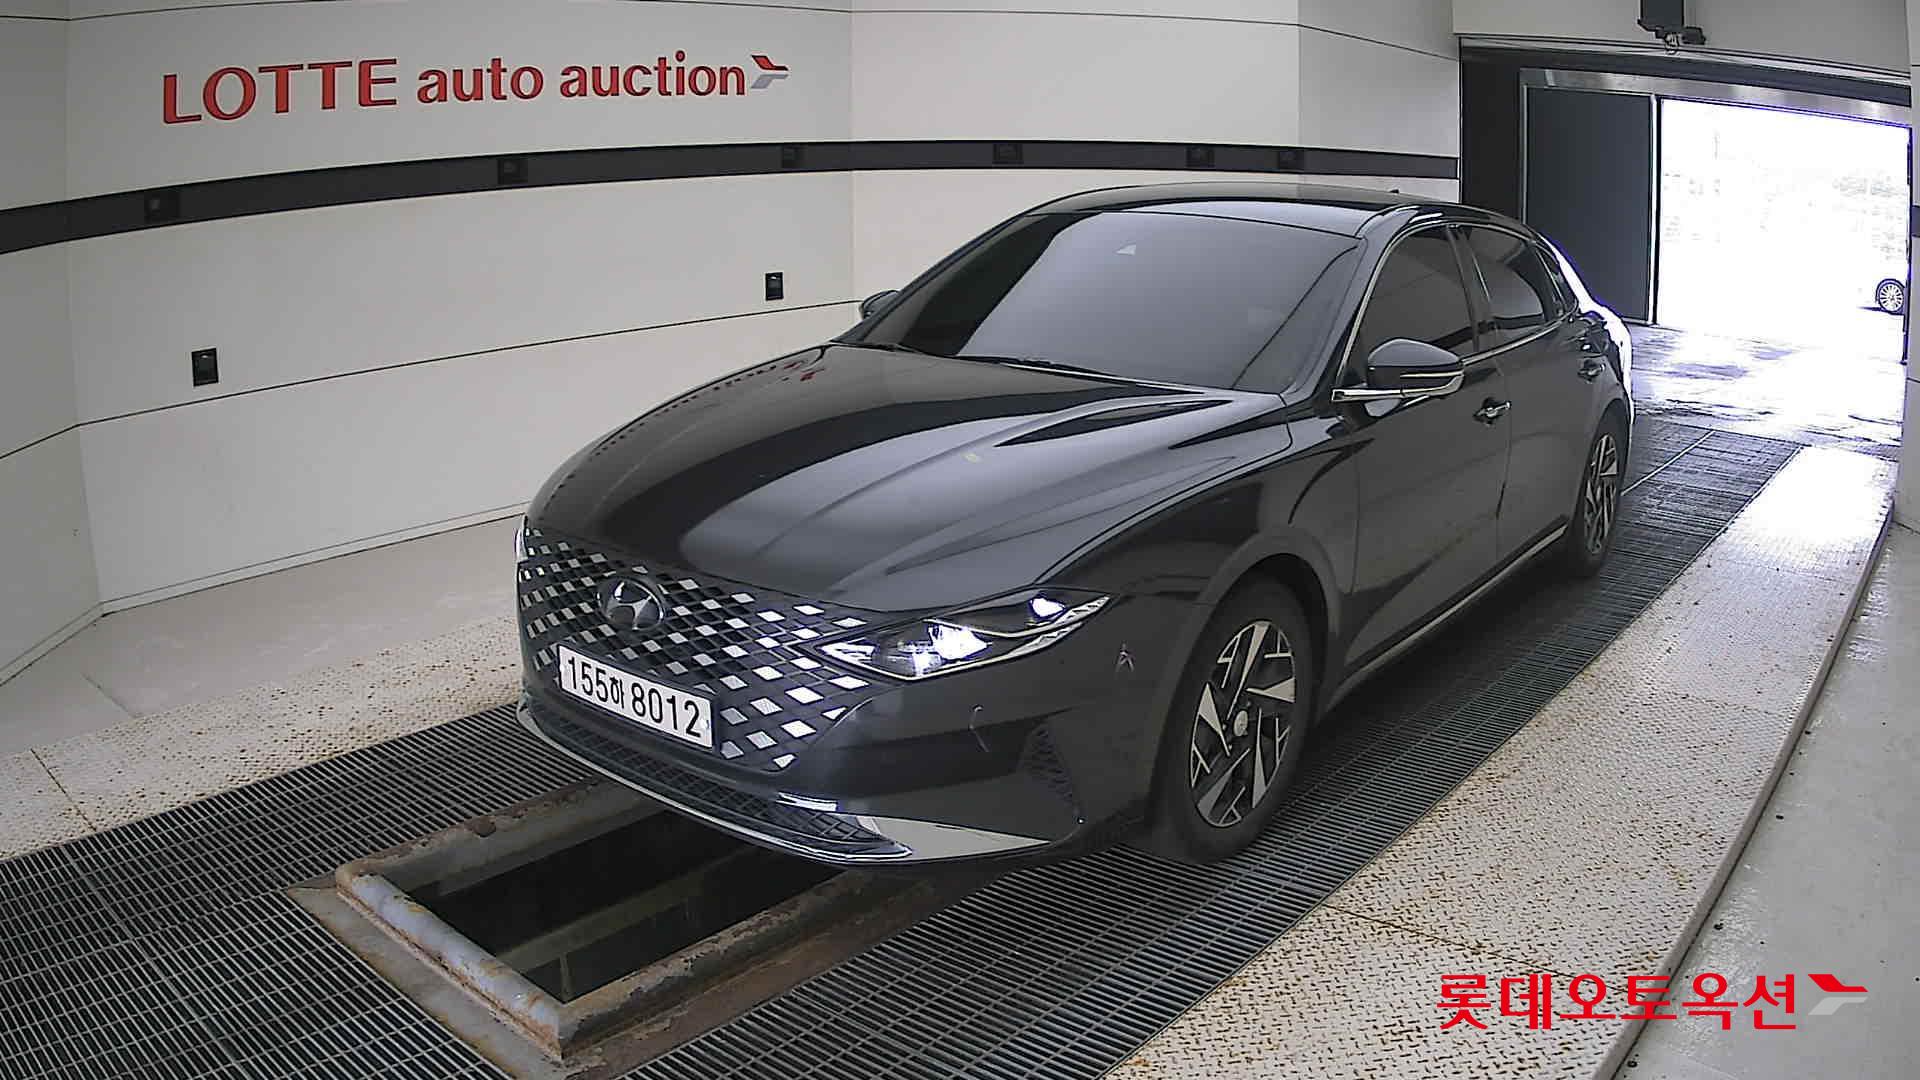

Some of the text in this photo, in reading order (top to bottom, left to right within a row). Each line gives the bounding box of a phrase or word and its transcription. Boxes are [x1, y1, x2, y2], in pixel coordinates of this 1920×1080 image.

[163, 50, 747, 125] LOTTE auto auction
[568, 656, 702, 739] 155하 8012
